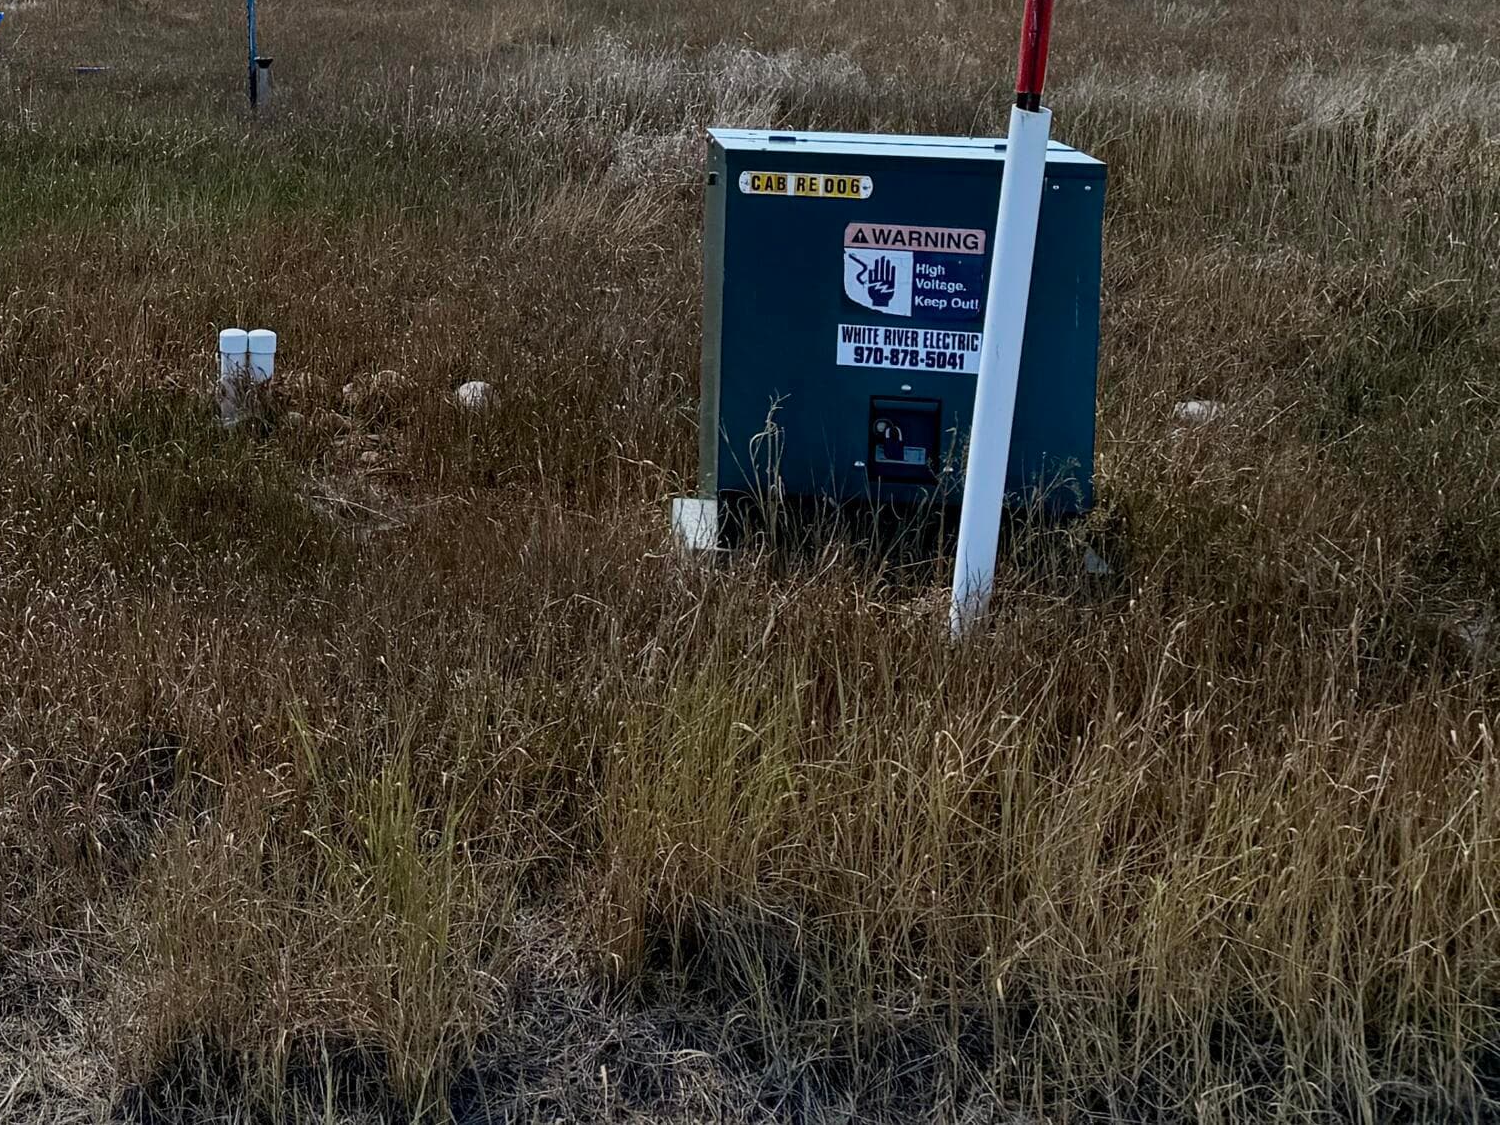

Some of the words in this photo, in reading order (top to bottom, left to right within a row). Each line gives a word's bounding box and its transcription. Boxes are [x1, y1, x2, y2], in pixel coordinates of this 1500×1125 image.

[751, 175, 787, 191] CAB
[796, 177, 818, 192] RE
[824, 178, 861, 194] 006
[872, 228, 979, 251] WARNING
[916, 263, 946, 277] High
[915, 278, 967, 293] Voltage.
[914, 295, 948, 309] Keep
[951, 298, 979, 310] Out!
[841, 326, 879, 346] WHITE
[884, 328, 919, 348] RIVER
[923, 331, 979, 352] ELECTRIC
[853, 346, 965, 370] 970-878-5041
